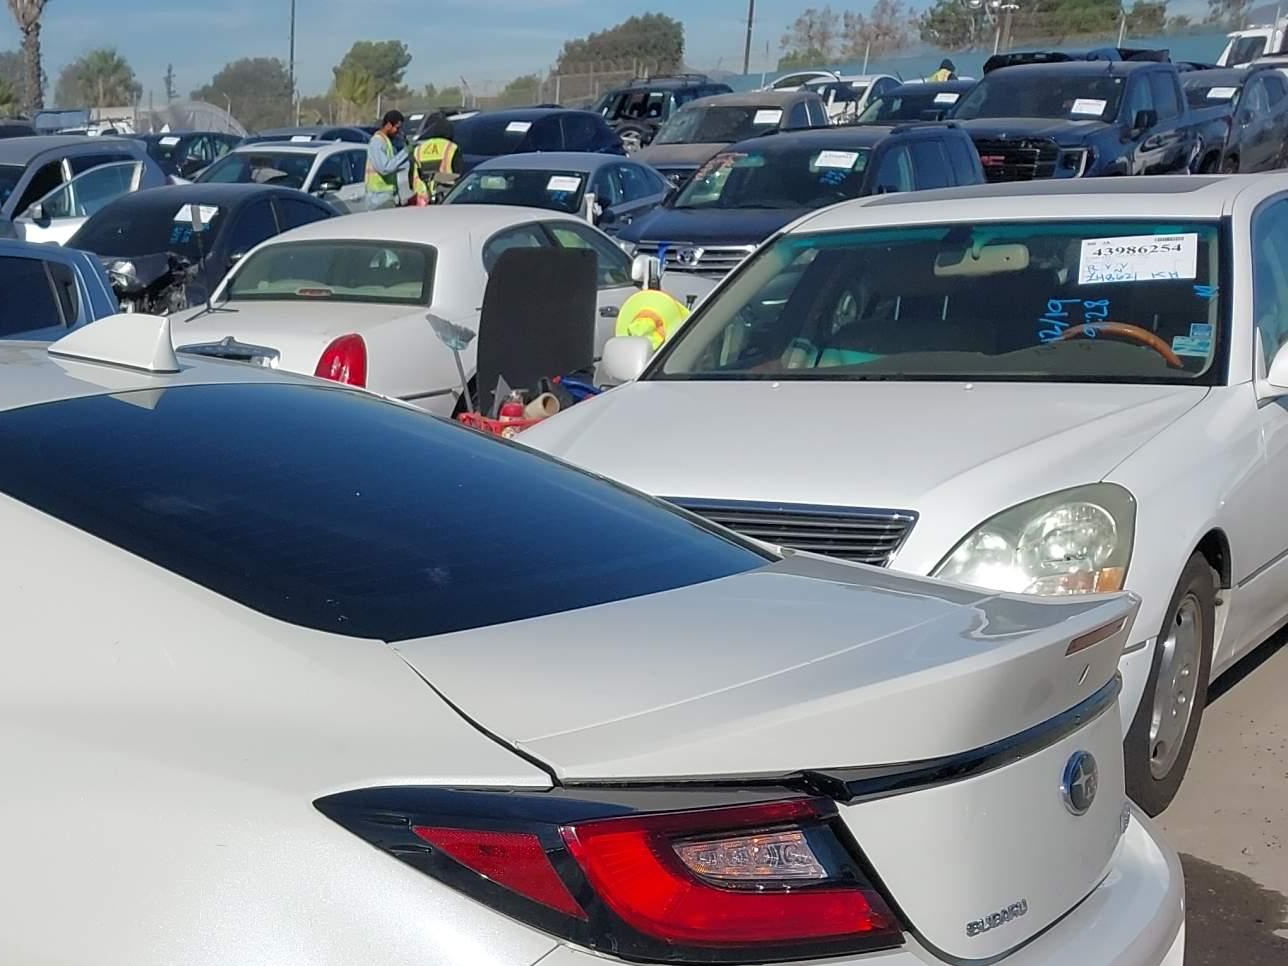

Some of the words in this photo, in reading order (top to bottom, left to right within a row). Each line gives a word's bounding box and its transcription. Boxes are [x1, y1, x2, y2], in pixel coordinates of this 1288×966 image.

[1092, 243, 1182, 256] 43986254
[1039, 298, 1082, 343] 12/19
[966, 898, 1028, 938] SUBARU
